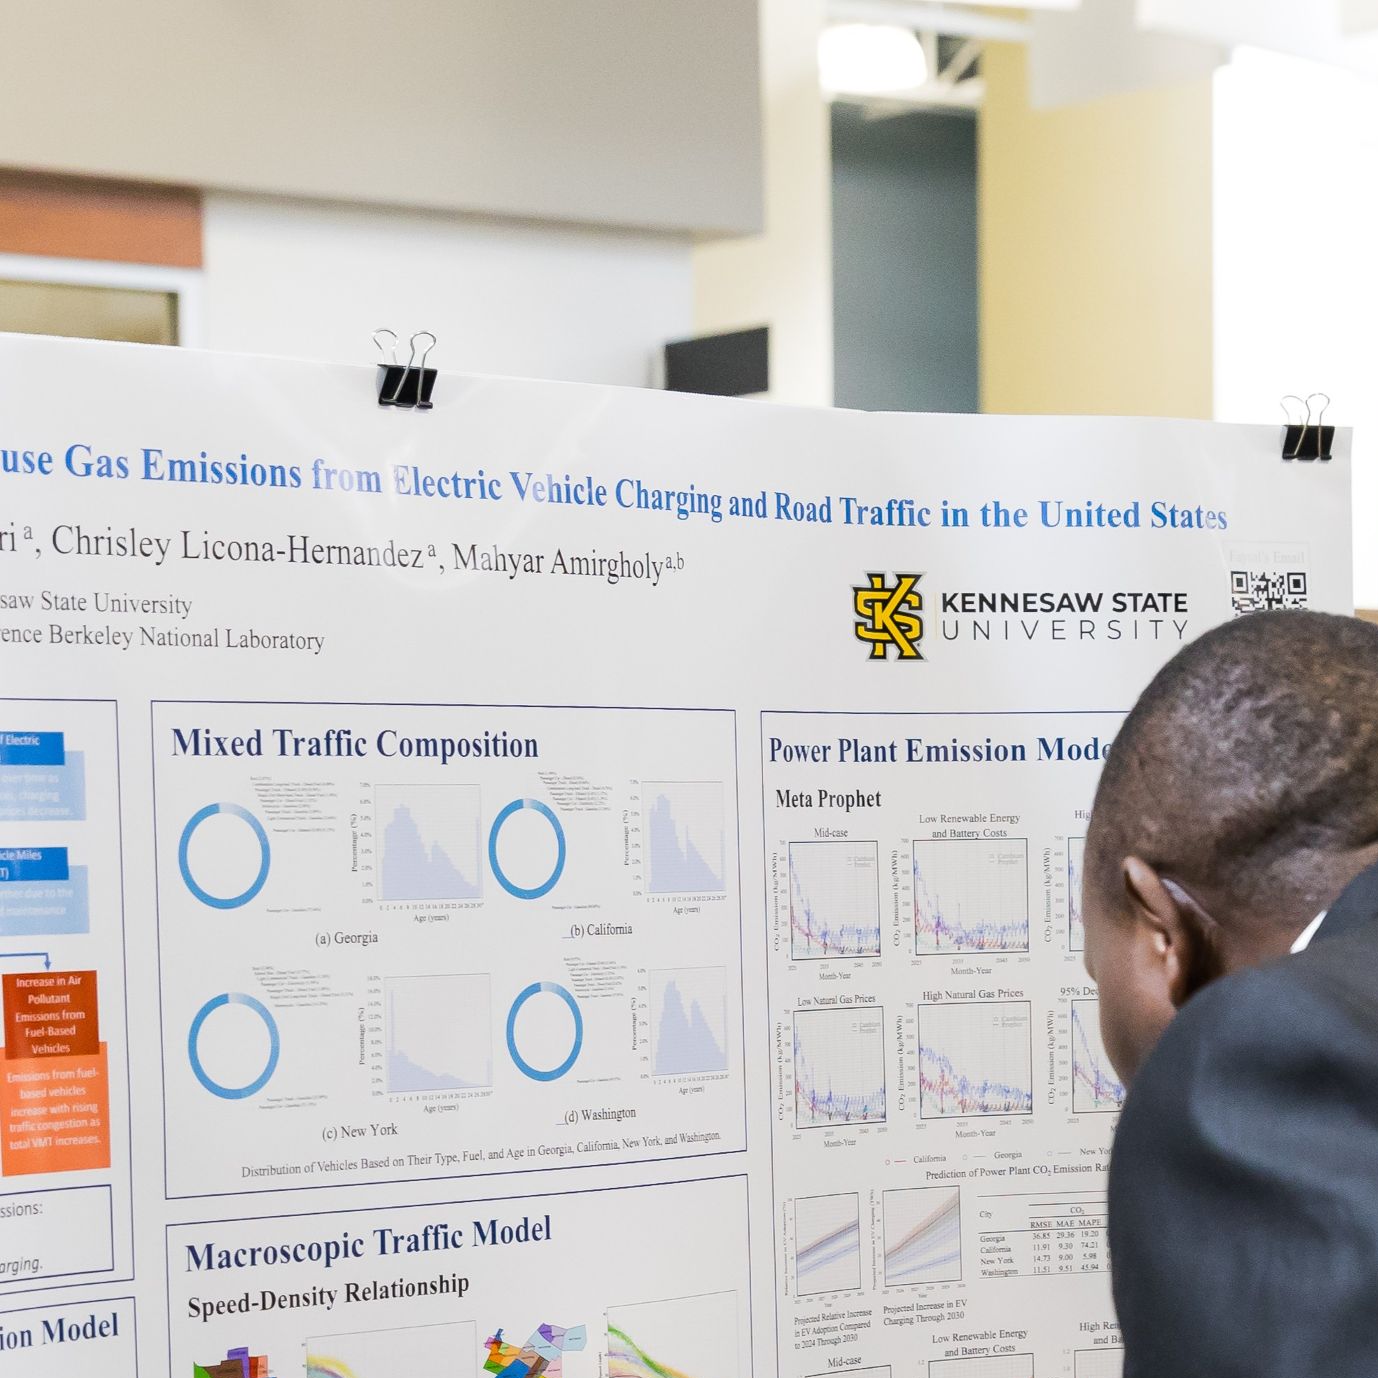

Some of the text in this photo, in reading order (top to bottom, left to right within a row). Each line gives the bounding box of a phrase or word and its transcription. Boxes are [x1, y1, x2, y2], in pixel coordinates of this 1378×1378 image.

[64, 444, 129, 480] Gas
[141, 448, 302, 489] Emissions
[312, 459, 381, 494] from
[393, 464, 501, 501] Electric
[510, 471, 607, 506] Vehicle
[615, 479, 722, 521] Charging
[729, 492, 768, 519] and
[775, 492, 832, 524] Road
[839, 496, 932, 527] Traffic
[941, 500, 969, 528] in
[981, 501, 1027, 528] the
[1037, 501, 1140, 529] United
[1150, 502, 1227, 530] States
[51, 526, 171, 565] Chrisley
[454, 543, 544, 576] Mahyar
[41, 591, 86, 613] State
[94, 592, 192, 619] University
[941, 592, 1188, 612] KENNESAW STATE
[941, 619, 1188, 641] UNIVERSITY
[49, 625, 133, 652] Berkeley
[140, 626, 219, 648] National
[225, 630, 325, 655] Laboratory
[171, 728, 539, 765] Mixed Traffic Composition
[769, 736, 1112, 764] Power Plant Emission Mode
[776, 789, 881, 812] Meta Prophet
[919, 813, 1020, 825] Low Renewable Energy
[814, 828, 848, 838] Mid-case
[932, 828, 1007, 839] and Battery Costs
[315, 931, 378, 946] (a) Georgia
[587, 924, 632, 936] California
[16, 976, 81, 988] Increase in Air
[28, 993, 70, 1005] Pollutant
[923, 988, 1024, 1003] High Natural Gas Prices
[15, 1010, 85, 1023] Emissions from
[25, 1026, 76, 1036] Fuel-Based
[31, 1043, 70, 1053] Vehicles
[581, 1108, 636, 1122] Washington
[322, 1123, 397, 1142] (c) New York
[241, 1165, 300, 1178] Distribution
[304, 1162, 317, 1173] of
[318, 1161, 358, 1173] Vehicles
[361, 1158, 389, 1170] Based
[392, 1158, 404, 1167] on
[407, 1155, 432, 1165] Their
[434, 1152, 460, 1166] Type,
[462, 1150, 485, 1162] Fuel,
[488, 1150, 504, 1160] and
[507, 1148, 525, 1160] Age
[527, 1146, 536, 1157] in
[538, 1144, 575, 1157] Georgia,
[577, 1140, 620, 1153] California,
[622, 1138, 639, 1149] New
[642, 1136, 661, 1148] York,
[664, 1135, 678, 1145] and
[185, 1215, 551, 1272] Macroscopic Traffic Model
[188, 1273, 469, 1322] Speed-Density Relationship
[42, 1312, 119, 1346] Model
